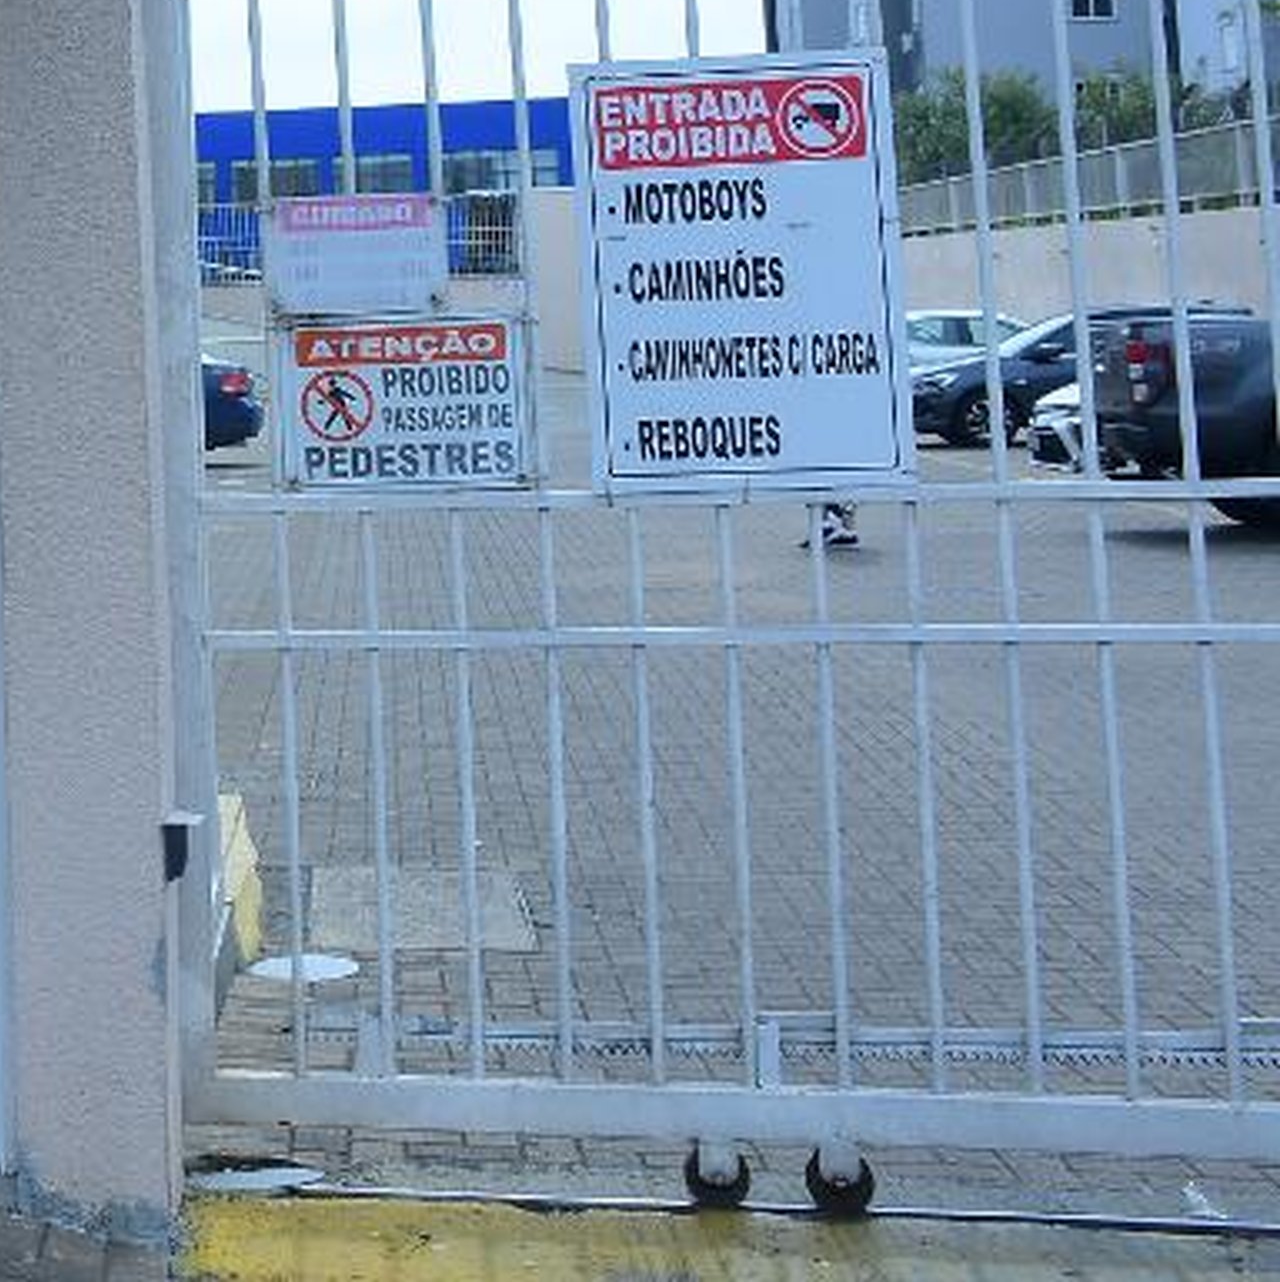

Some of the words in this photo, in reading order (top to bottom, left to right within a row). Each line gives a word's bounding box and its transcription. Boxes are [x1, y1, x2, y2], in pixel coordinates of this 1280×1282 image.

[598, 88, 771, 128] ENTRADA
[604, 122, 777, 163] PROIBIDA
[624, 177, 768, 225] MOTOBOYS
[308, 330, 497, 362] ATENÇÃO
[811, 332, 882, 376] CARGA
[381, 363, 511, 398] PROIBIDO
[382, 403, 483, 433] PASSAGEM
[489, 403, 514, 429] DE
[638, 416, 782, 460] REBOQUES
[304, 440, 516, 480] PEDESTRES
